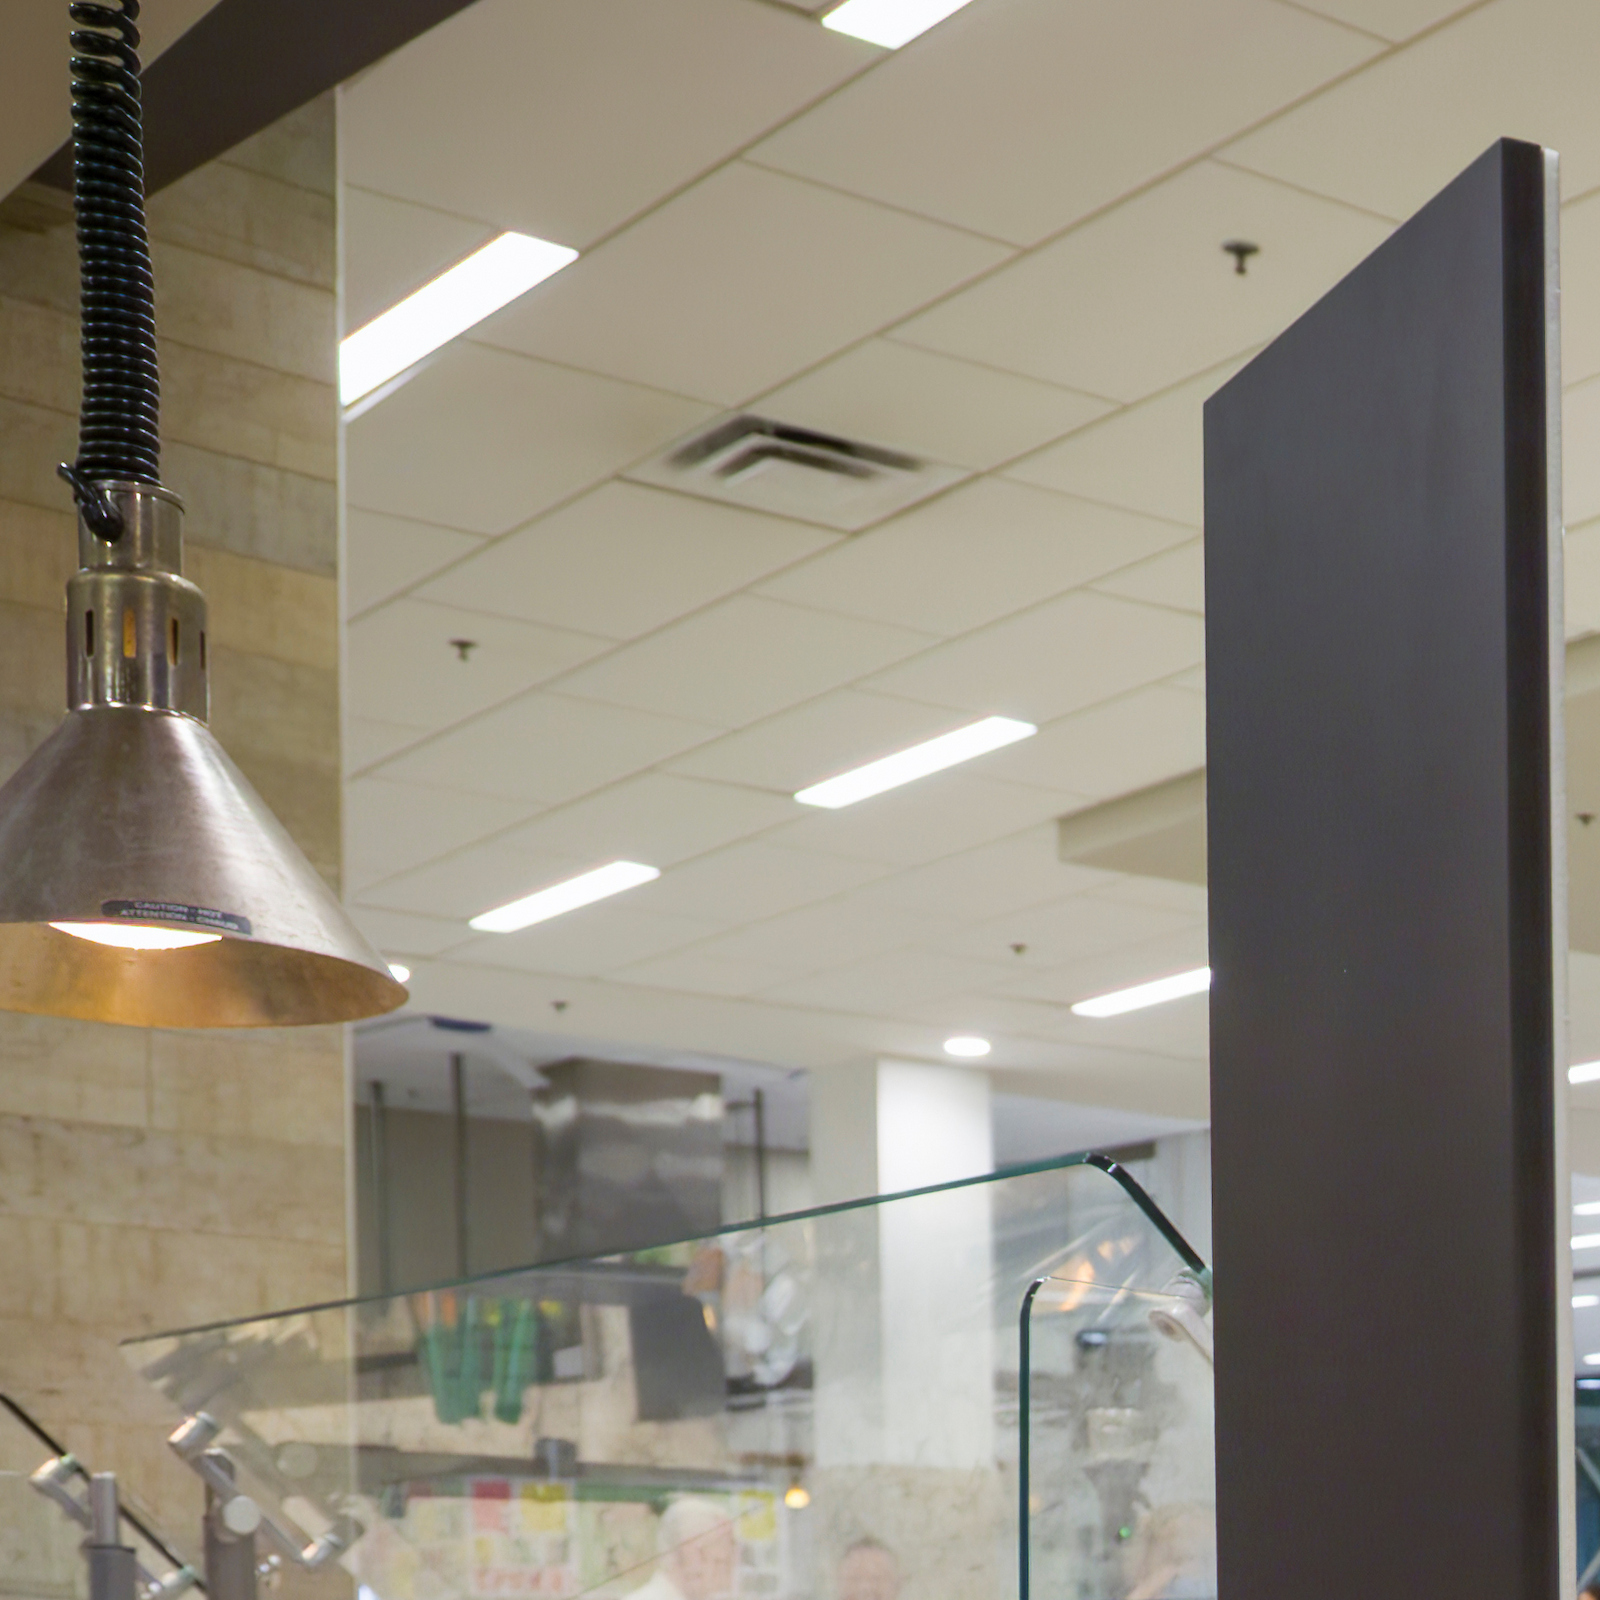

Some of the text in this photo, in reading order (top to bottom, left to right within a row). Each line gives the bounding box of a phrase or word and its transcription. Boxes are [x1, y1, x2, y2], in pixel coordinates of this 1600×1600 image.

[120, 909, 188, 921] ATTENTION
[133, 901, 188, 914] CAUTION
[197, 907, 223, 919] HOT
